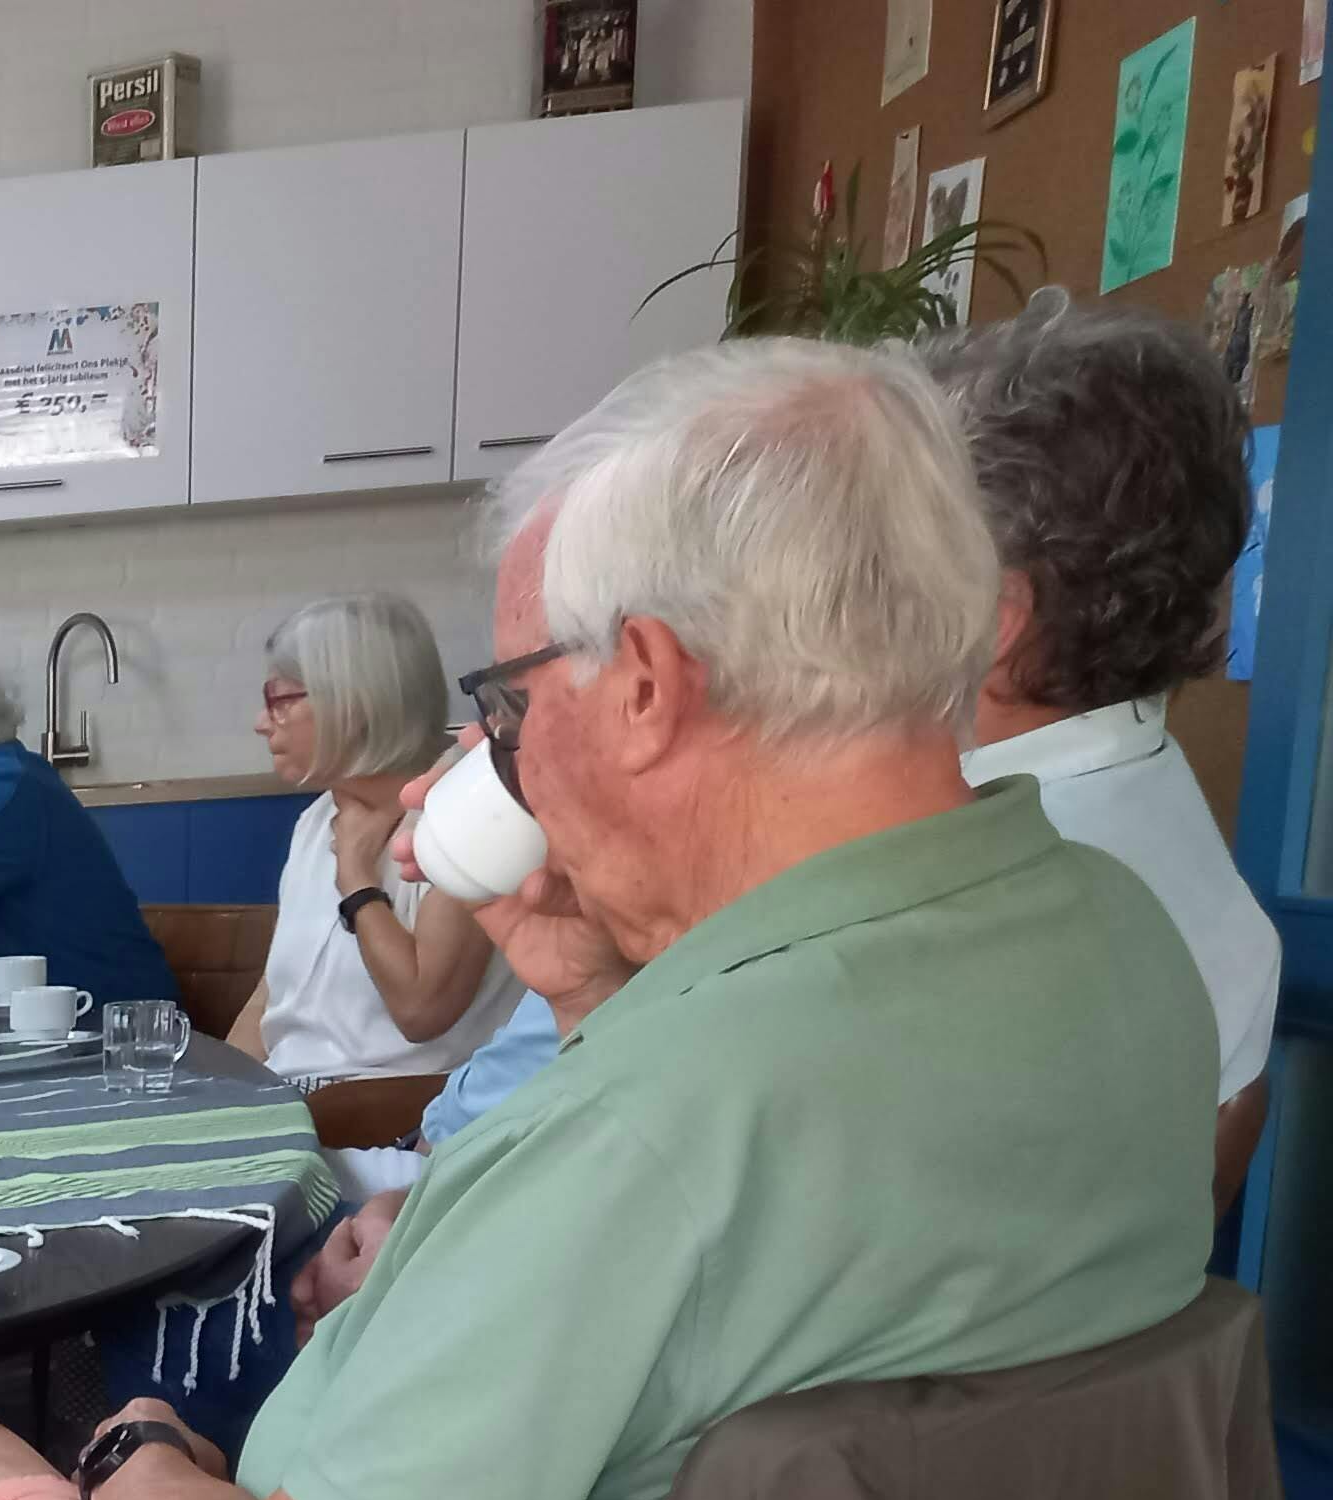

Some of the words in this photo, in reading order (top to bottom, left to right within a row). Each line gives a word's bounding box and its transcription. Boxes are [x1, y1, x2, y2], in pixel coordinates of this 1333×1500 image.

[100, 69, 159, 109] Persil
[36, 361, 79, 373] feliciteert
[81, 359, 99, 369] Ons
[100, 356, 129, 369] Plekje
[4, 377, 21, 387] met
[23, 376, 38, 386] het
